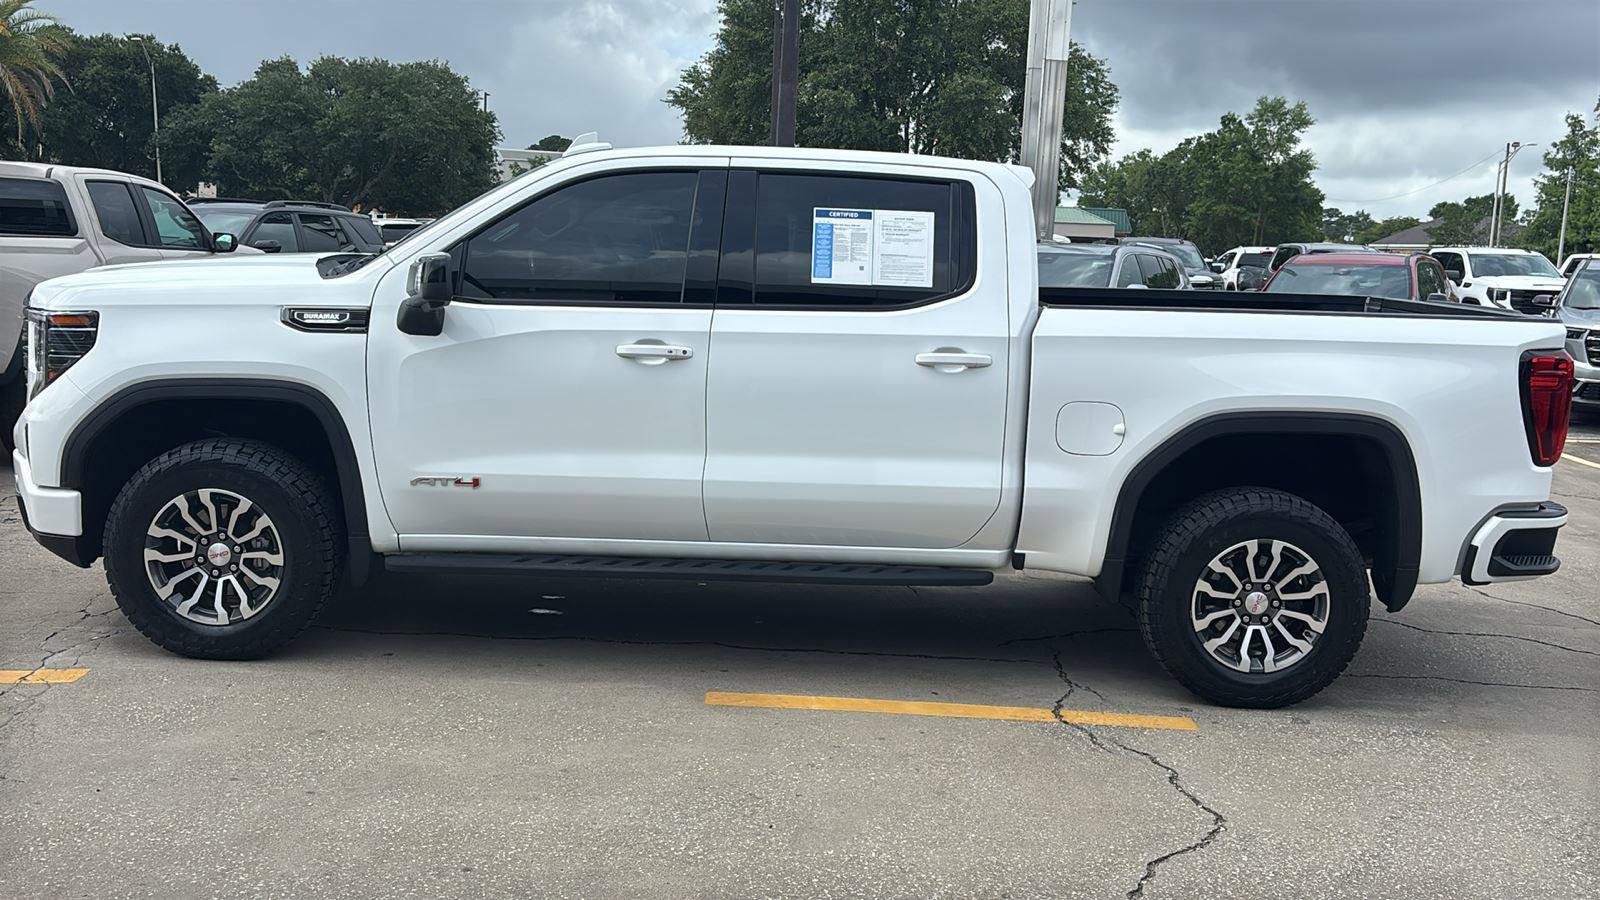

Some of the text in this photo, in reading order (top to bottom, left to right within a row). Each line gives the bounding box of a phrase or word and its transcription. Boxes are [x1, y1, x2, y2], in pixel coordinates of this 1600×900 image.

[303, 312, 340, 320] DURAMAX
[410, 475, 480, 488] AT4
[209, 550, 229, 559] GMC
[1251, 594, 1263, 613] GMC
